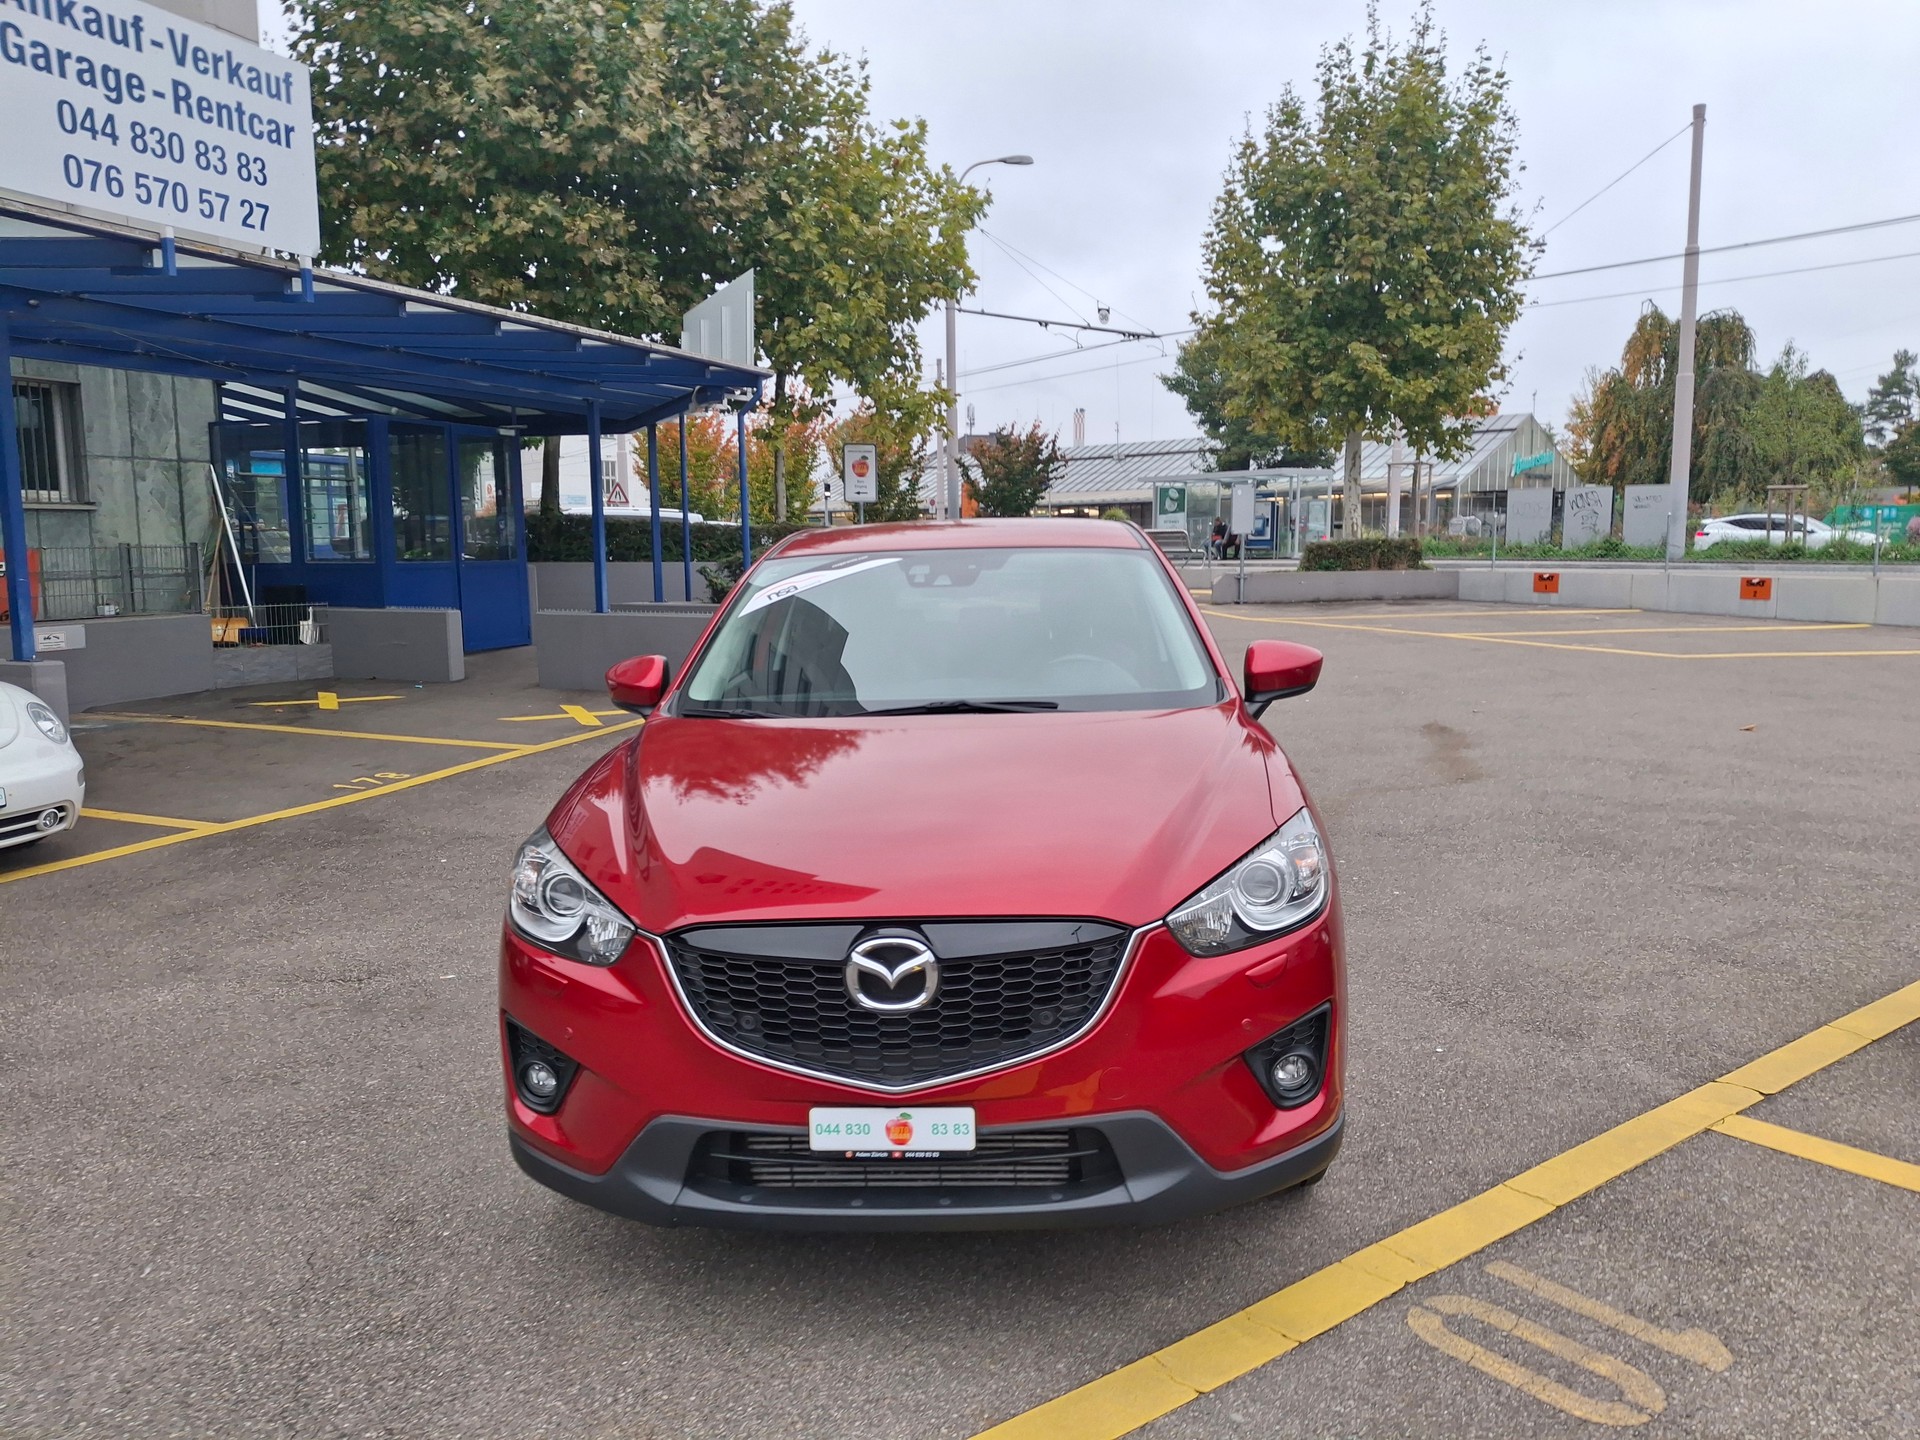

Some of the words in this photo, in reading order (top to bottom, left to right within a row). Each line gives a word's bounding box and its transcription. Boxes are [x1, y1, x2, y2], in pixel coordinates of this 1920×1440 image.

[0, 0, 293, 104] nkauf-Verkauf
[57, 99, 119, 146] 044
[130, 121, 184, 164] 830
[195, 140, 228, 176] 83
[237, 152, 268, 186] 83
[63, 153, 124, 198] 076
[134, 172, 189, 214] 570
[198, 188, 230, 222] 57
[239, 199, 270, 231] 27
[767, 585, 799, 601] nsa
[333, 772, 411, 789] 178
[815, 1123, 841, 1135] 044
[845, 1123, 871, 1135] 830
[931, 1123, 948, 1135] 83
[953, 1123, 970, 1135] 83
